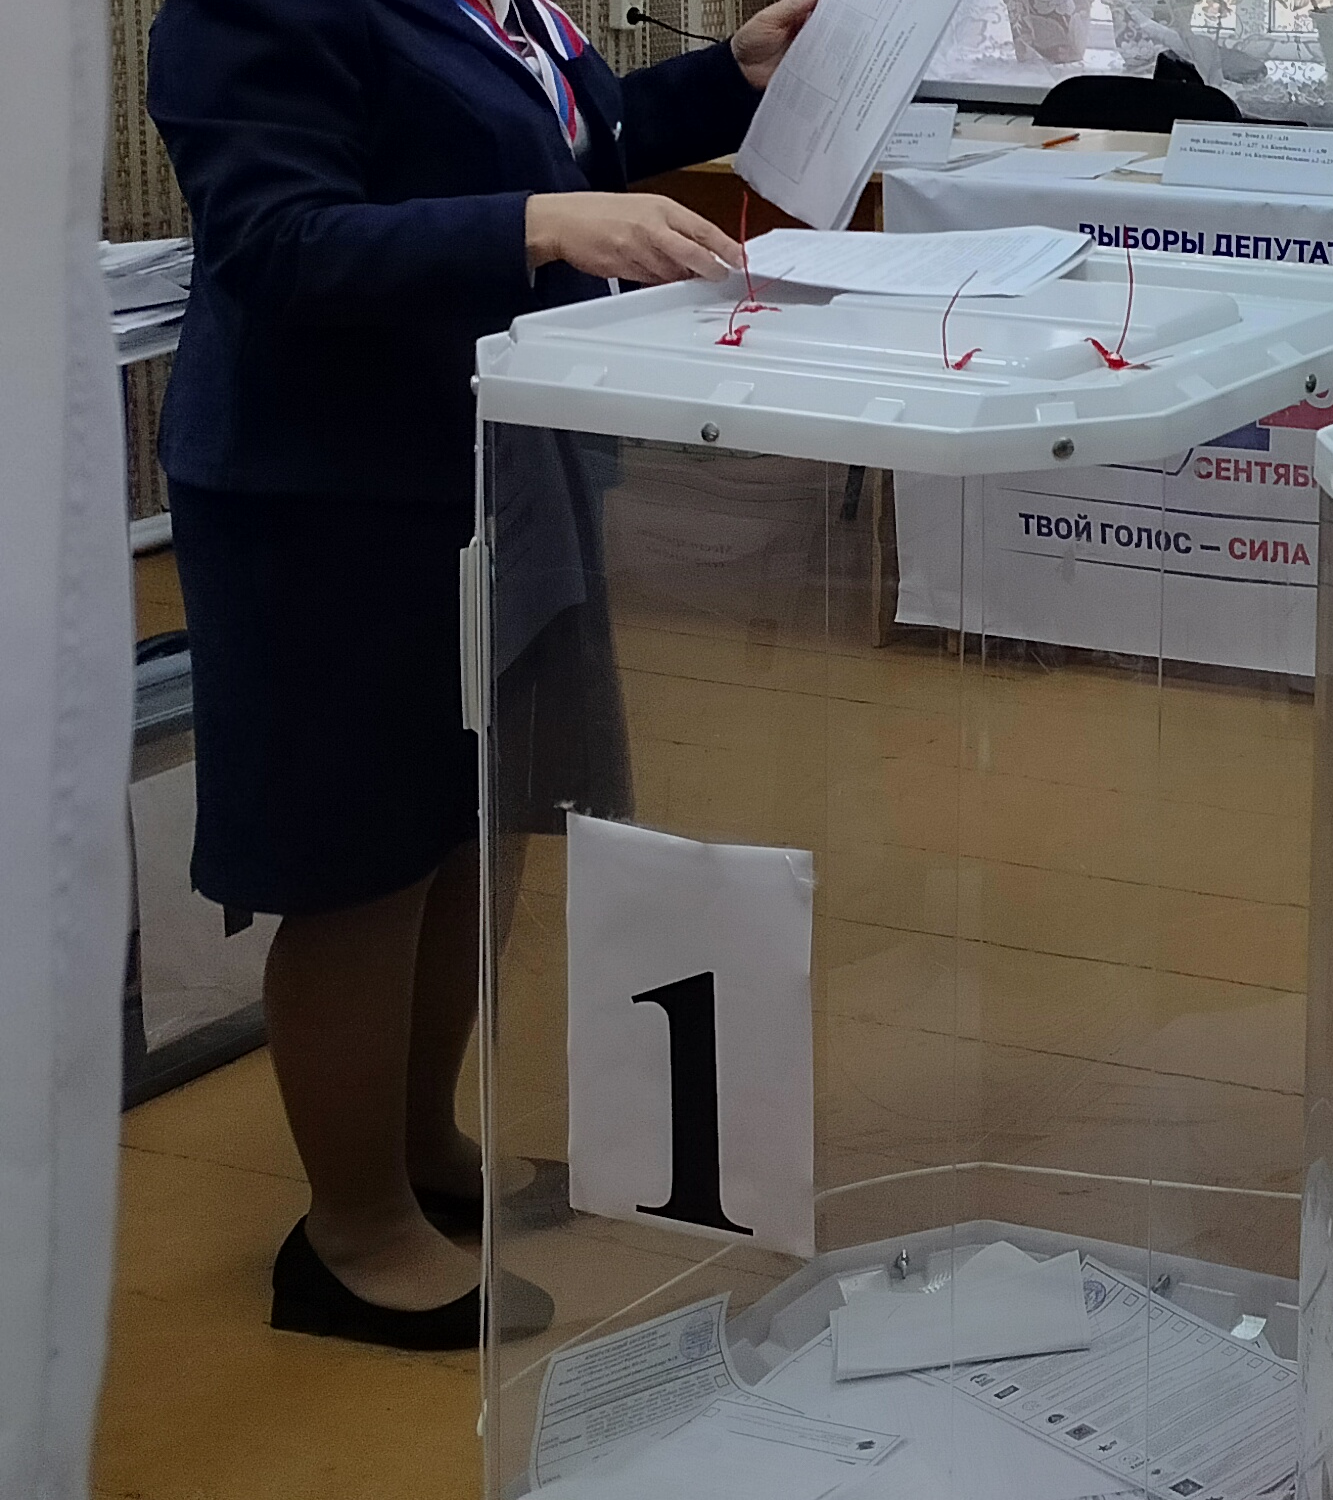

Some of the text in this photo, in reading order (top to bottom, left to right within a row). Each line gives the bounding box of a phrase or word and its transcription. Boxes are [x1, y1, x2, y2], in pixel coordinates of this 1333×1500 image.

[1079, 222, 1204, 254] ВЫБОРЫ
[1193, 456, 1317, 489] СЕНТЯБ
[1018, 512, 1092, 543] ТВОЙ
[1100, 523, 1193, 555] ГОЛОС
[1228, 537, 1311, 566] СИЛА
[631, 971, 754, 1236] 1
